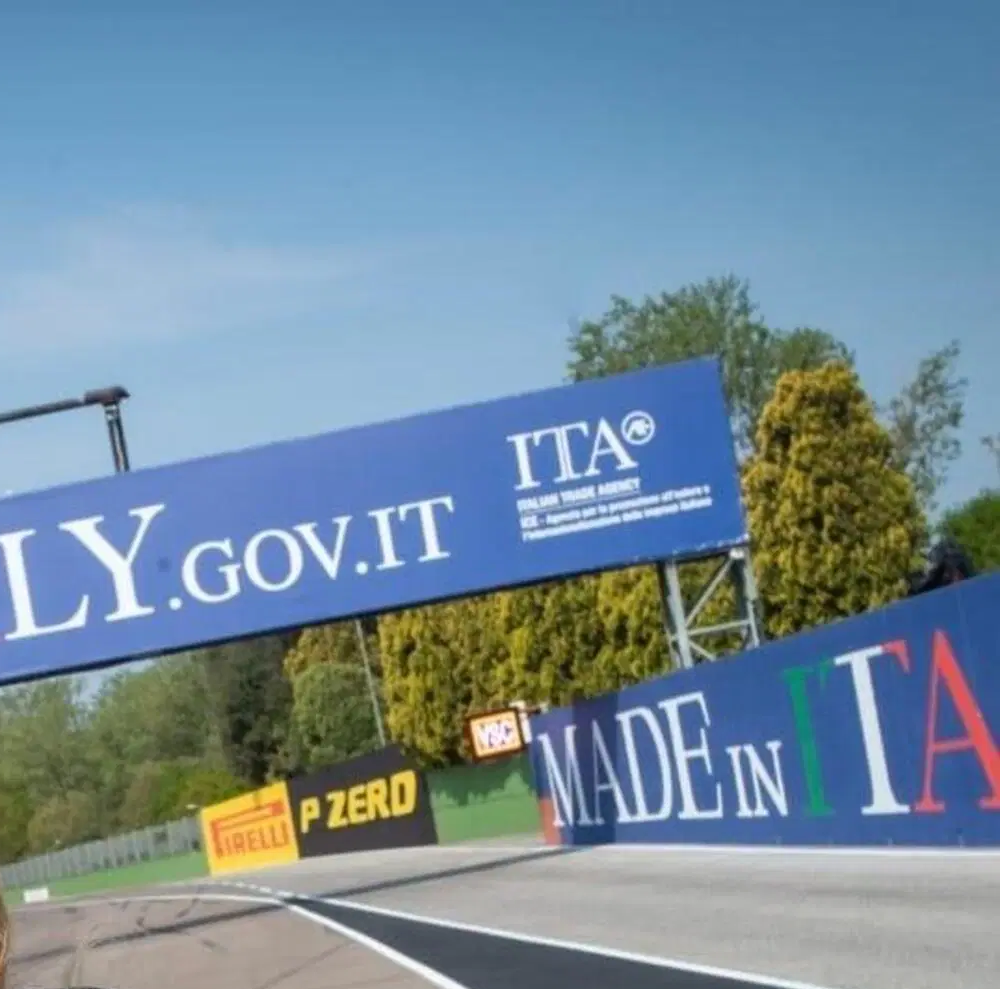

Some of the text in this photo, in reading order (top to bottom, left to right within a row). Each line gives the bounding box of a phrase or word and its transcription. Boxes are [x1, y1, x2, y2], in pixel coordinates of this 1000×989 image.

[506, 416, 638, 490] ITA
[537, 692, 723, 828] MADE
[726, 740, 788, 818] IN
[211, 802, 289, 859] PIRELLI
[301, 769, 418, 833] P ZERO
